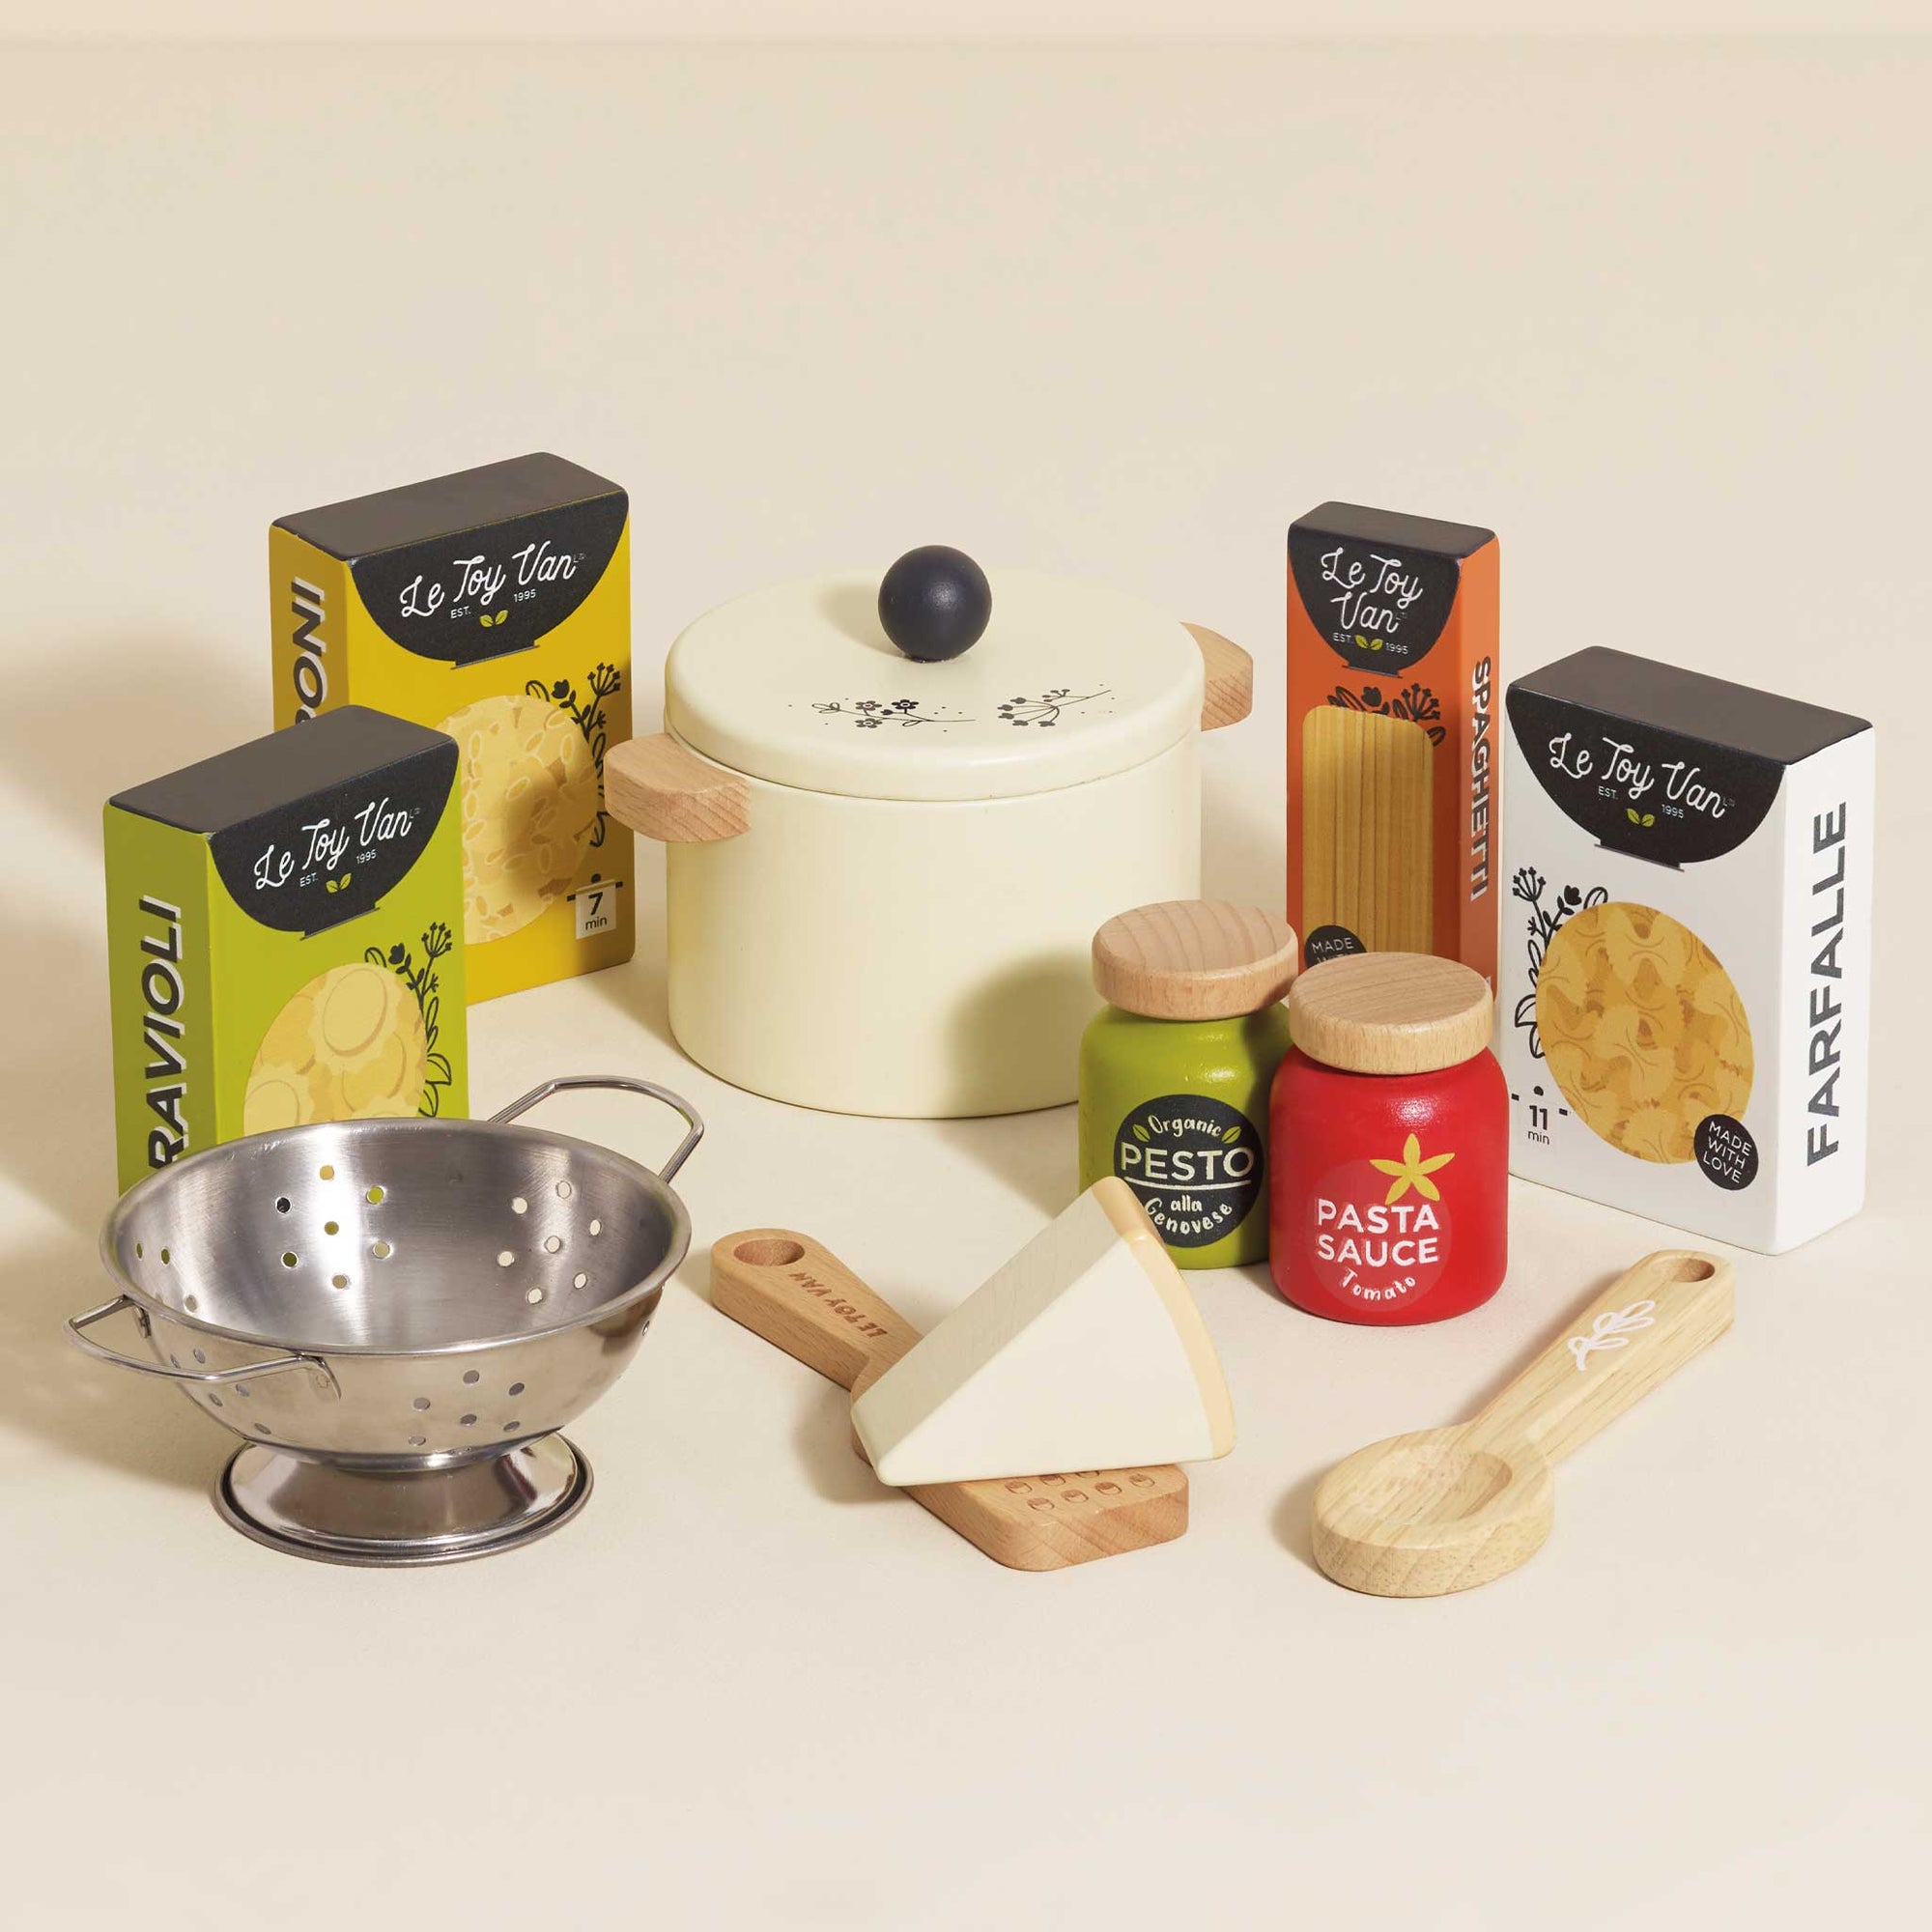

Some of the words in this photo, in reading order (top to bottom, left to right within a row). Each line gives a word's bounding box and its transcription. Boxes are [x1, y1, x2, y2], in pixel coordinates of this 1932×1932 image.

[399, 575, 445, 617] Le
[453, 554, 506, 606] Toy
[512, 540, 577, 585] Van
[1321, 547, 1366, 589] Le
[1370, 554, 1424, 610] Toy
[514, 588, 537, 603] 1995
[1330, 591, 1399, 634] Van
[1385, 641, 1408, 655] 1995
[1470, 656, 1492, 901] SPAGHETTI
[1548, 732, 1593, 780] Le
[1601, 736, 1655, 800] Toy
[1662, 761, 1726, 819] Van
[1662, 804, 1685, 819] 1995
[254, 844, 296, 891] Le
[301, 818, 351, 871] Toy
[354, 797, 412, 847] Van
[355, 849, 378, 865] 1995
[588, 891, 604, 916] 7
[584, 916, 608, 931] min
[1311, 937, 1354, 954] MADE
[1806, 802, 1847, 1167] FARFALLE
[138, 895, 189, 1170] RAVIOLI
[1148, 1115, 1222, 1138] Organic
[1528, 1104, 1548, 1131] 11
[1527, 1130, 1550, 1146] min
[1707, 1135, 1746, 1170] WITH
[1709, 1121, 1752, 1157] MADE
[1121, 1141, 1254, 1182] PESTO
[1702, 1151, 1742, 1184] LOVE
[1144, 1197, 1233, 1236] Genovese
[1170, 1194, 1203, 1212] alla
[1317, 1198, 1439, 1235] PASTA
[1317, 1235, 1439, 1266] SAUCE
[787, 1272, 833, 1297] VAN
[1342, 1267, 1416, 1301] Tomato
[823, 1298, 867, 1323] TOY
[856, 1321, 888, 1338] LE
